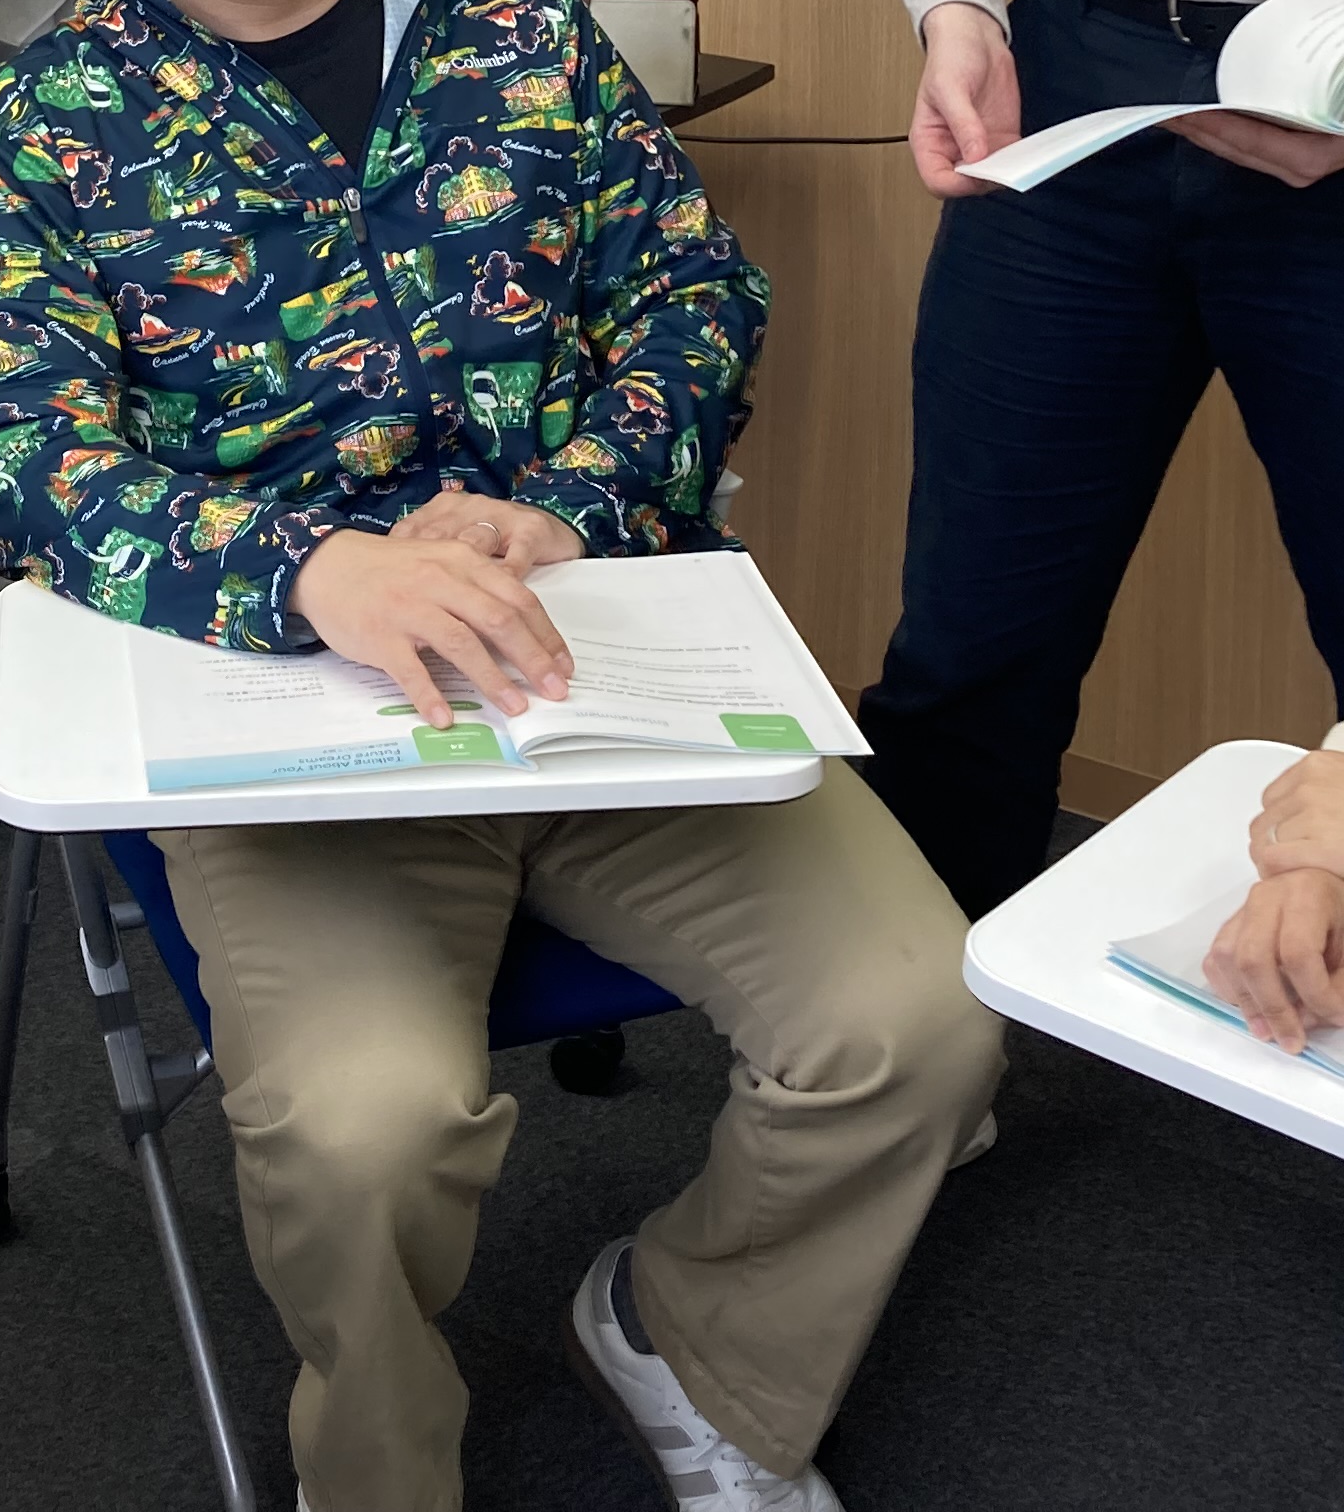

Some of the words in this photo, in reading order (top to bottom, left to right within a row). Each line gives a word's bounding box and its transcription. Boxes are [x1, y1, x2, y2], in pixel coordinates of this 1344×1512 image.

[451, 49, 518, 71] Columbia
[120, 157, 162, 178] Columbia
[151, 351, 189, 369] Cannon
[297, 752, 351, 764] Dreams
[353, 755, 402, 767] Talking
[270, 764, 305, 775] Your
[307, 759, 348, 771] About
